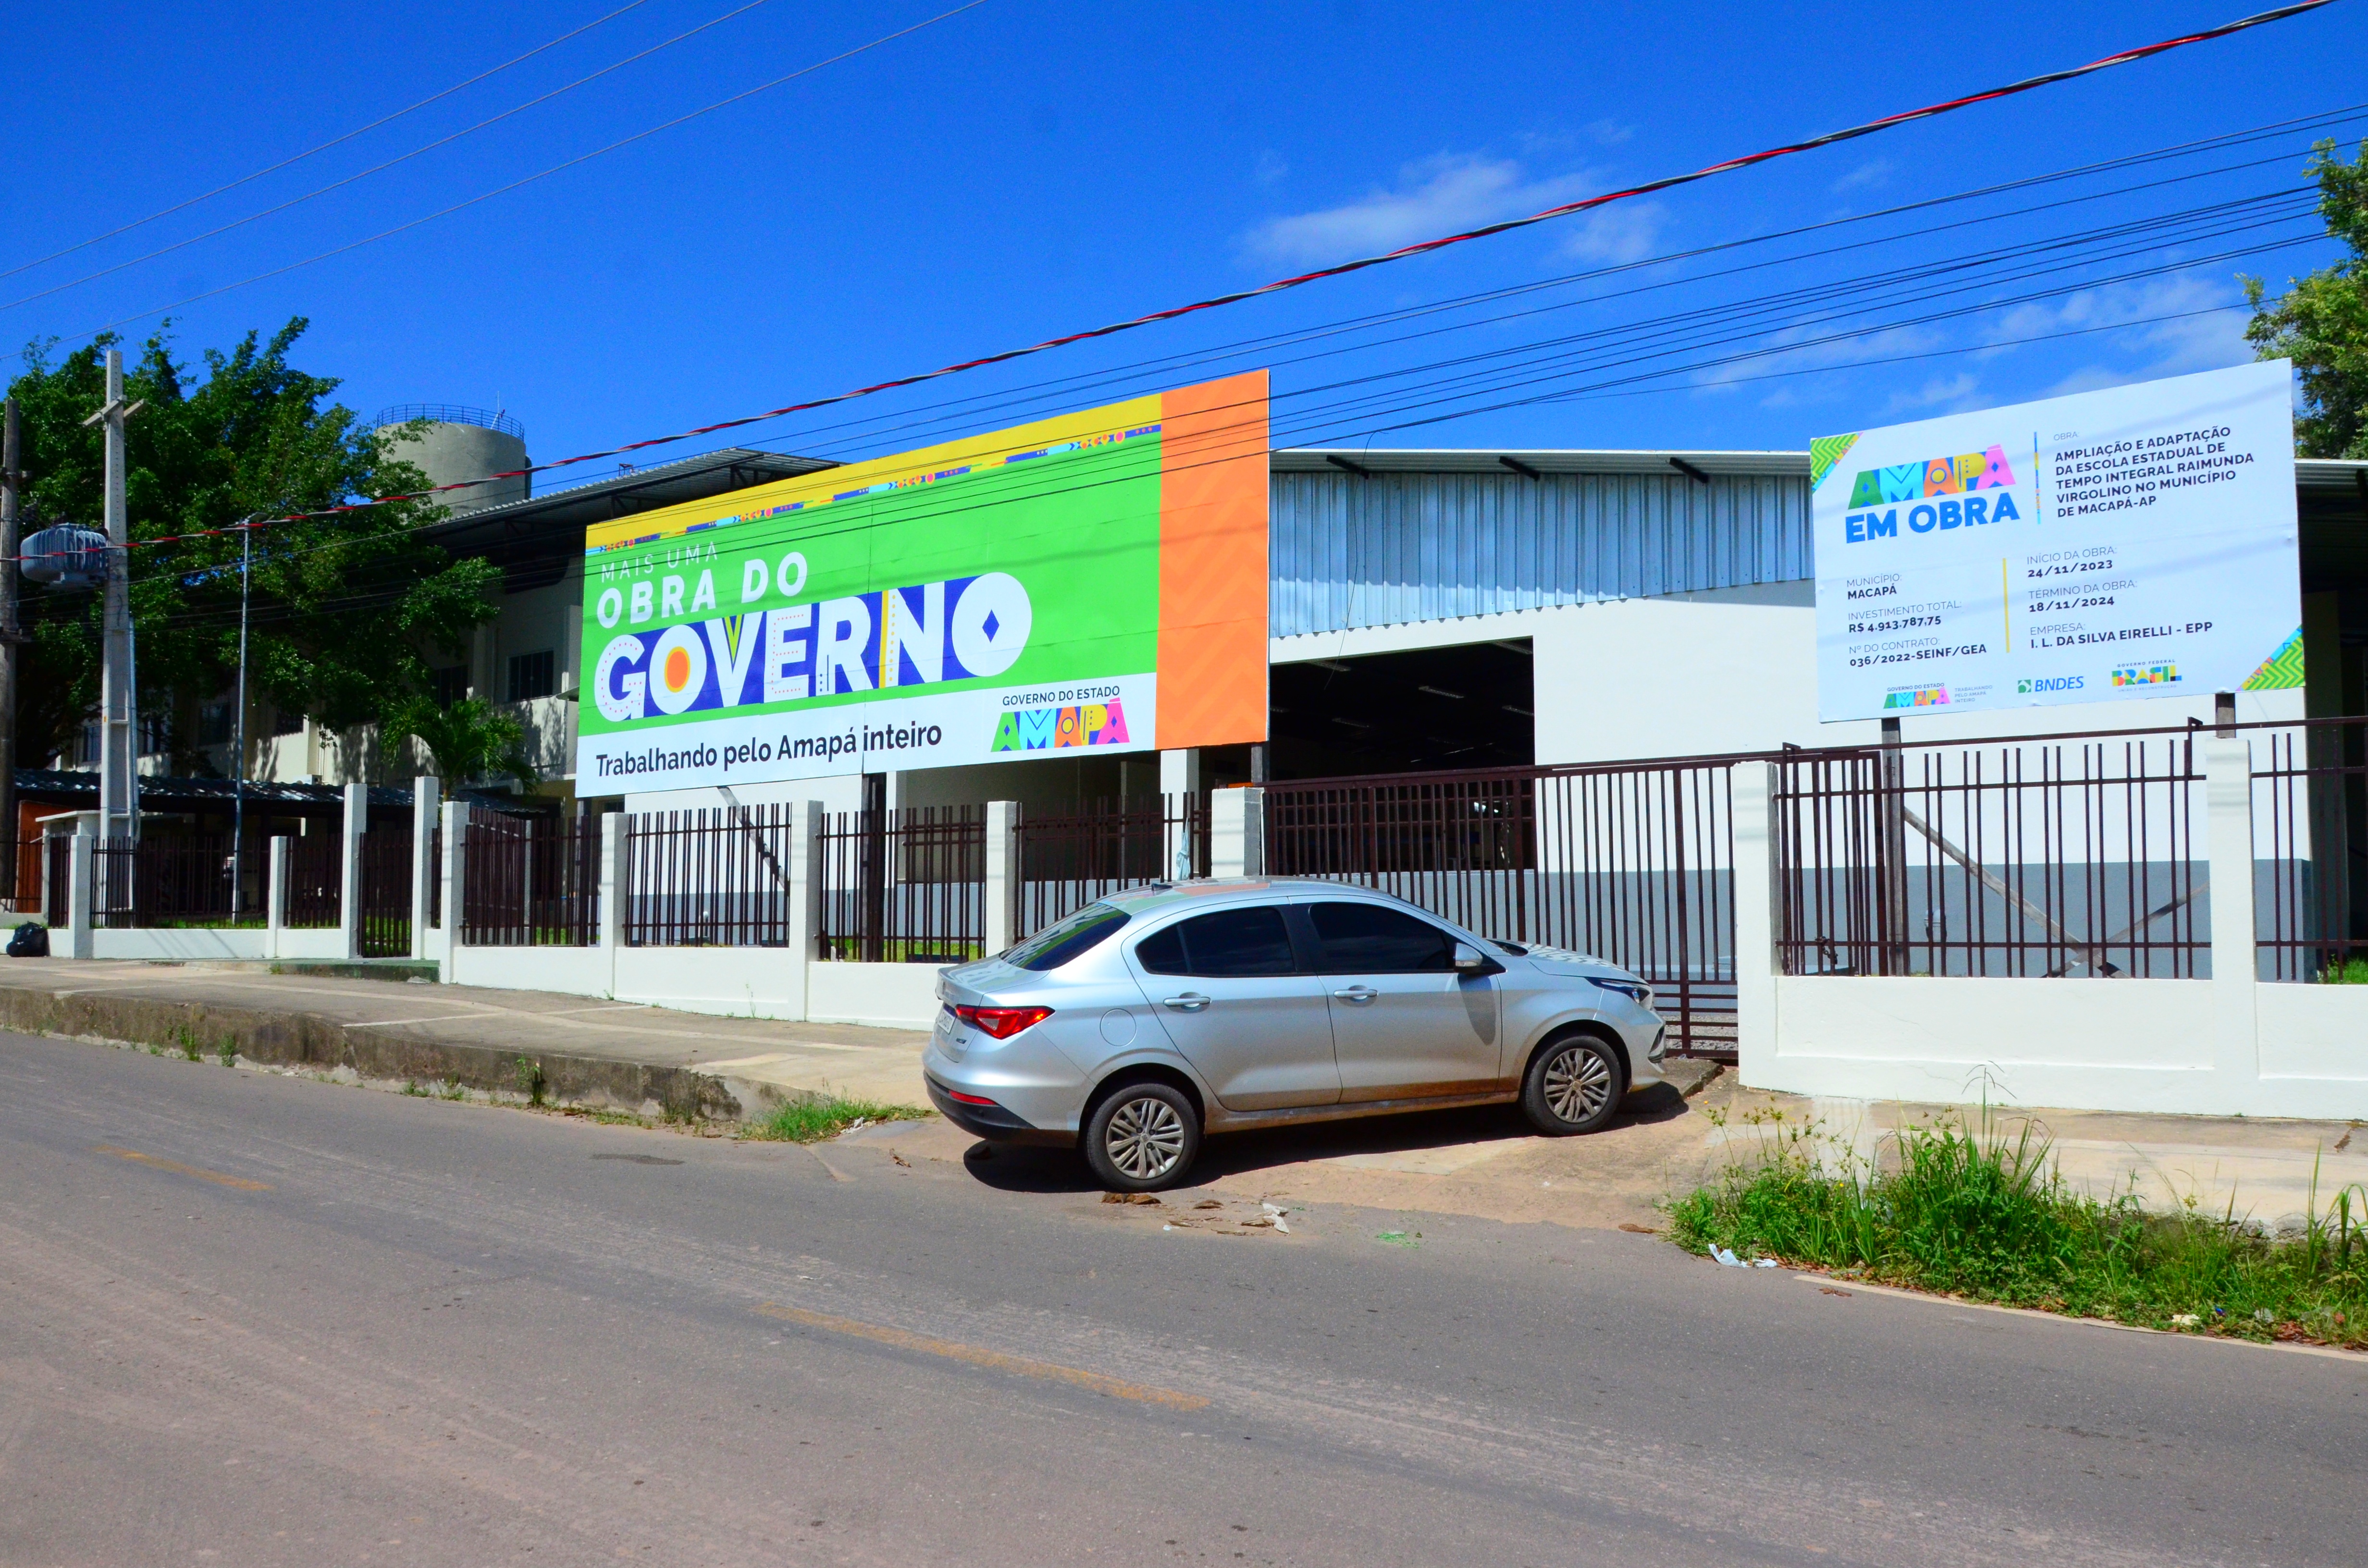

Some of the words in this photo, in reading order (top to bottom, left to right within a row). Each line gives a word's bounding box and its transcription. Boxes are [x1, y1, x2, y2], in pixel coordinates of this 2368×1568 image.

[2053, 431, 2079, 441] OBRA:
[2055, 441, 2132, 462] AMPLIAÇÃO
[2136, 440, 2144, 450] E
[2147, 426, 2231, 448] ADAPTAÇÃO
[2056, 465, 2073, 476] DA
[2077, 456, 2129, 473] ESCOLA
[2133, 445, 2204, 465] ESTADUAL
[2207, 442, 2225, 453] DE
[1848, 444, 2016, 510] AMAPÁ
[2056, 475, 2102, 490] TEMPO
[2106, 465, 2174, 483] INTEGRAL
[2177, 453, 2254, 473] RAIMUNDA
[2057, 485, 2132, 503] VIRGOLINO
[2135, 481, 2156, 493] NO
[2160, 470, 2236, 490] MUNICÍPIO
[2058, 507, 2074, 517] DE
[2078, 496, 2156, 515] MACAPÁ-AP
[1845, 509, 1897, 543] EM
[1908, 492, 2020, 533] OBRA
[602, 554, 654, 583] MAIS
[667, 541, 717, 568] UMA
[2027, 553, 2060, 564] INÍCIO
[2064, 551, 2079, 560] DA
[2082, 546, 2117, 557] OBRA:
[2028, 560, 2113, 578] 24/11/2023
[597, 569, 716, 628] OBRA
[741, 551, 807, 603] DO
[1847, 574, 1902, 587] MUNICÍPIO:
[2028, 586, 2080, 599] TÉRMINO
[2084, 584, 2099, 593] DA
[2102, 580, 2137, 591] OBRA:
[1848, 583, 1897, 600] MACAPÁ
[1849, 604, 1924, 620] INVESTIMENTO
[1926, 600, 1961, 611] TOTAL:
[2029, 596, 2114, 612] 18/11/2024
[1849, 622, 1864, 633] R$
[1867, 615, 1941, 632] 4.913.787,75
[2030, 623, 2085, 635] EMPRESA:
[1850, 645, 1862, 654] Nº
[1864, 644, 1879, 653] DO
[1882, 637, 1940, 650] CONTRATO:
[2031, 639, 2038, 649] I.
[2042, 638, 2052, 648] L.
[2057, 636, 2074, 646] DA
[2078, 632, 2115, 644] SILVA
[2120, 625, 2171, 640] EIRELLI
[2186, 622, 2212, 633] EPP
[594, 572, 1032, 722] GOVERNO
[1850, 644, 1986, 667] 036/2022-SEINF/GEA
[2035, 676, 2084, 692] BNDES
[2111, 665, 2182, 686] BRASIL
[1003, 692, 1055, 706] GOVERNO
[1059, 690, 1073, 701] DO
[1077, 686, 1120, 699] ESTADO
[1883, 686, 1950, 709] AMAPÁ
[990, 697, 1130, 752] AMAPÁ
[596, 742, 717, 777] Trabalhando
[724, 736, 771, 771] pelo
[777, 726, 857, 762] Amapá
[863, 721, 942, 752] inteiro
